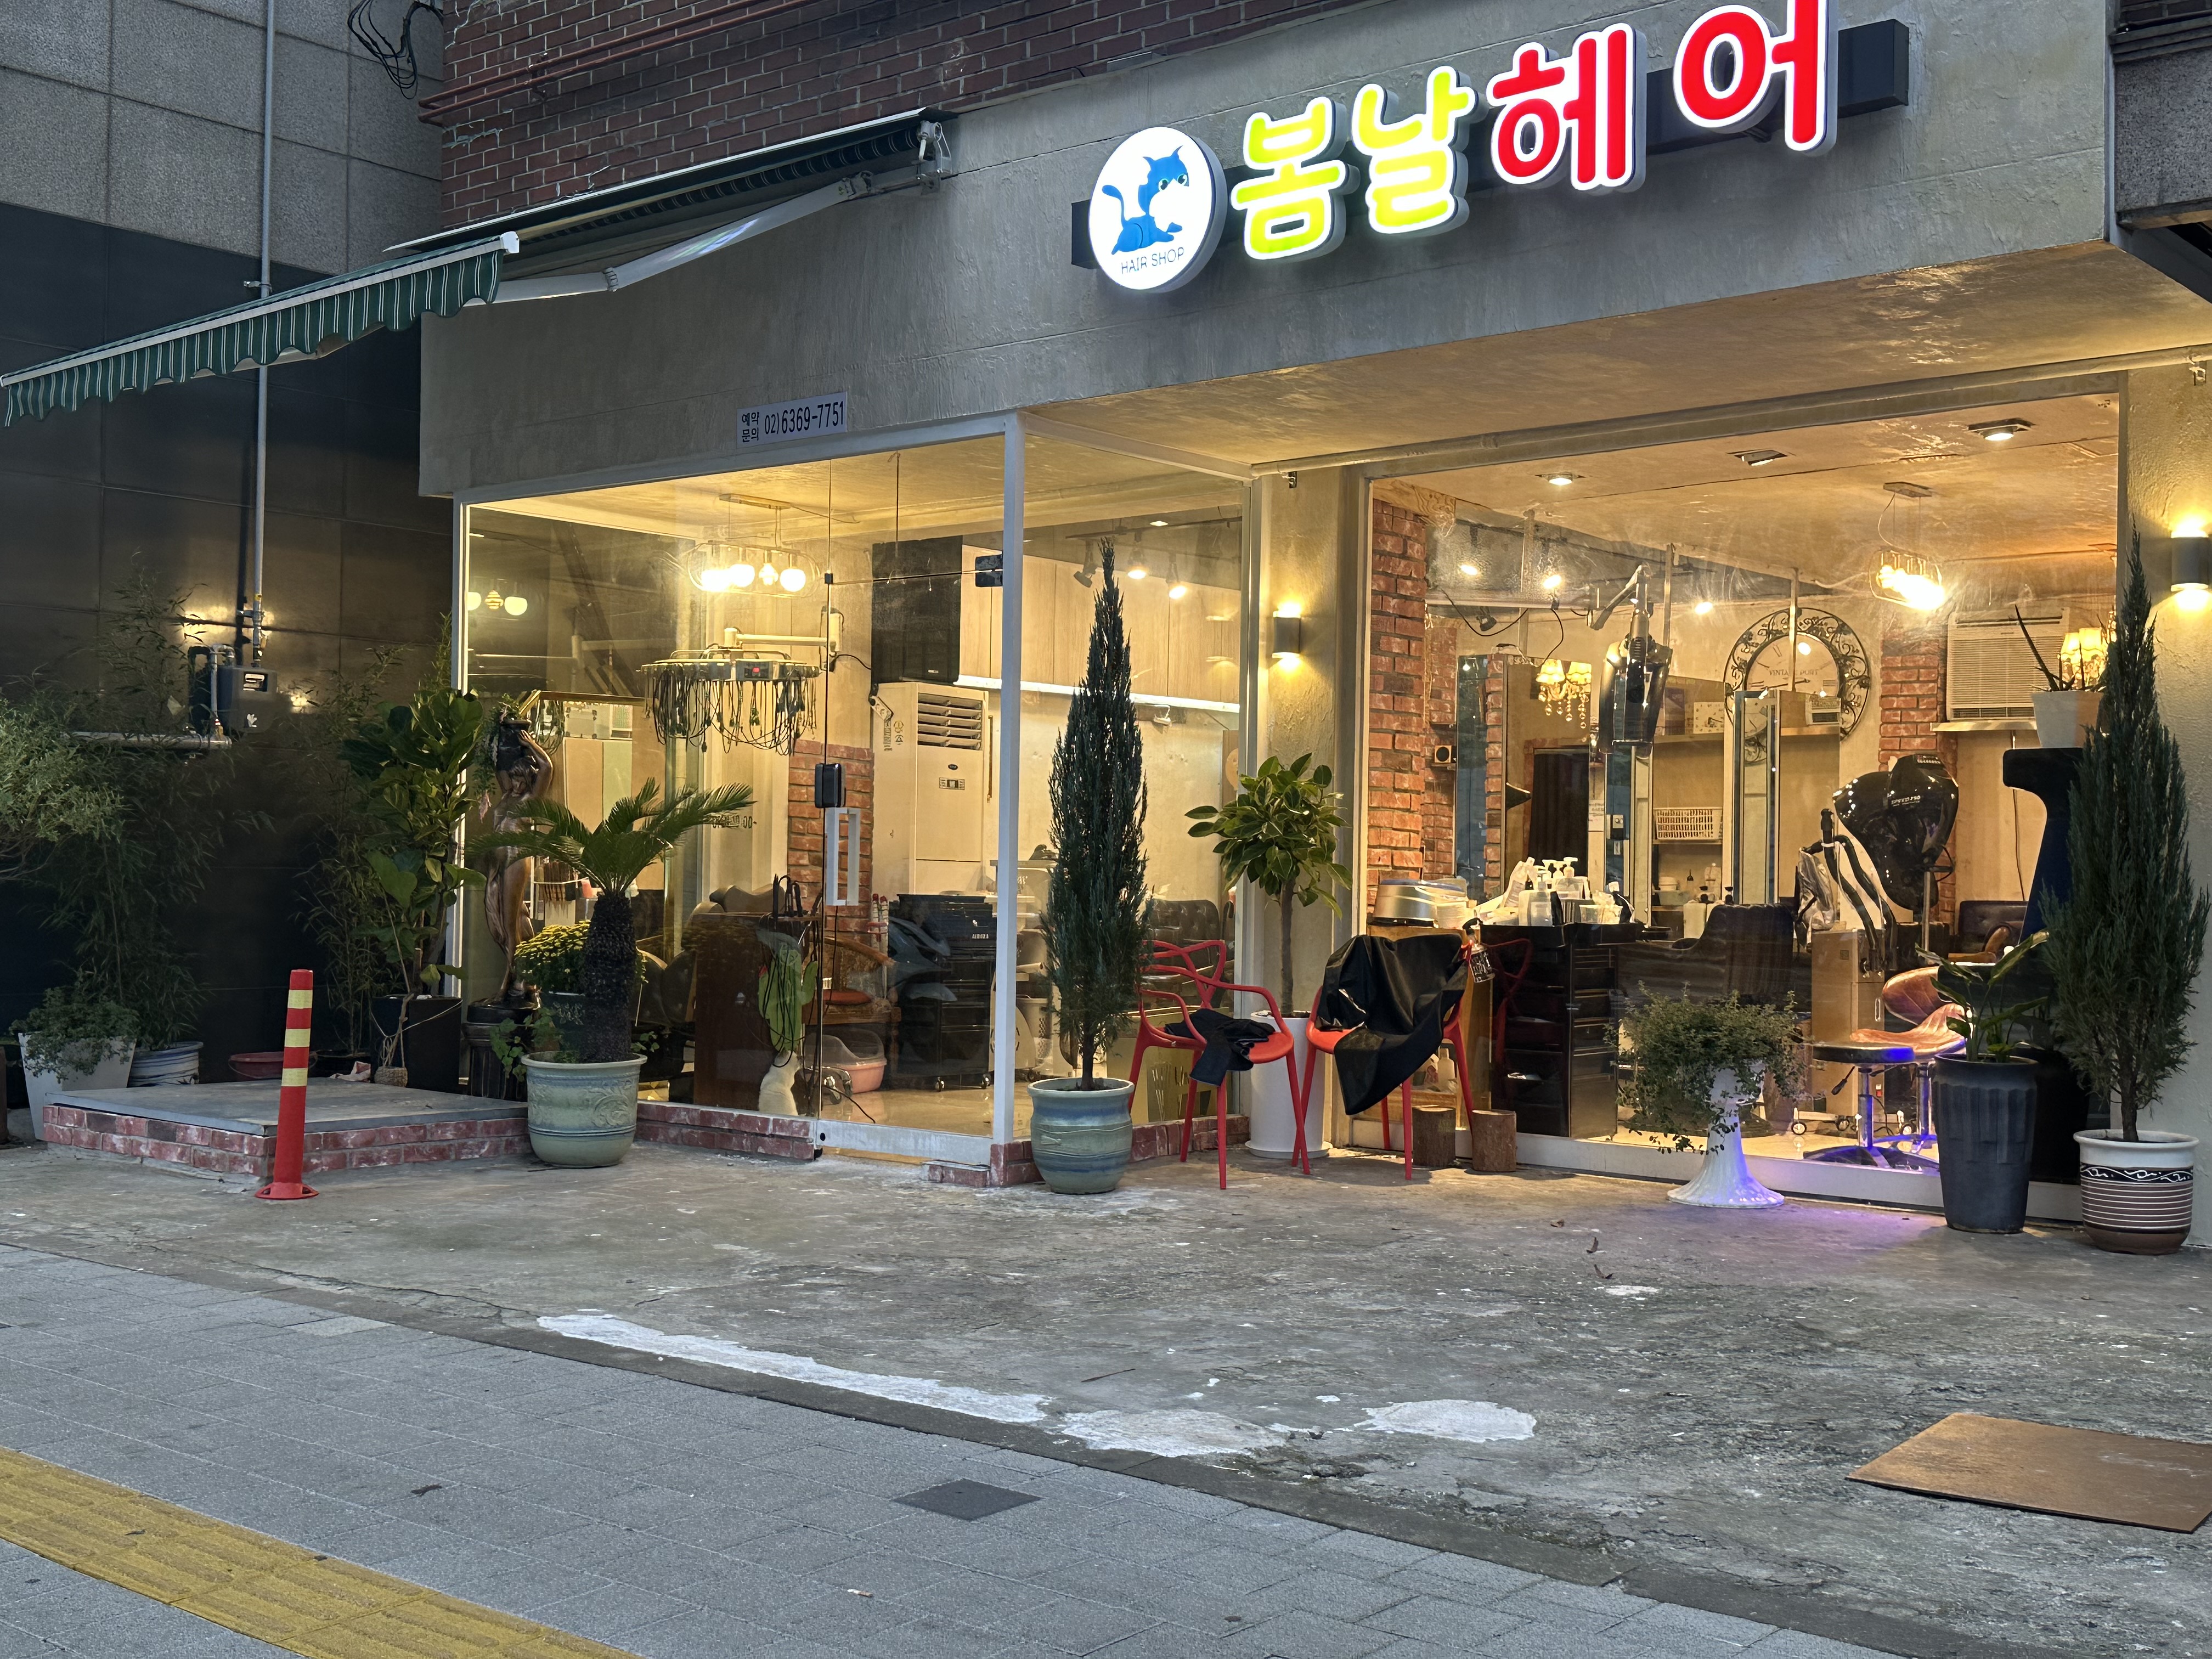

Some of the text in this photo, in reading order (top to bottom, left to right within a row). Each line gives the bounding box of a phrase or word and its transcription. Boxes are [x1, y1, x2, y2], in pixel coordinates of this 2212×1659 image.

[1120, 247, 1184, 274] HAIR SHOP
[742, 411, 760, 426] 예약
[742, 427, 759, 443] 문의
